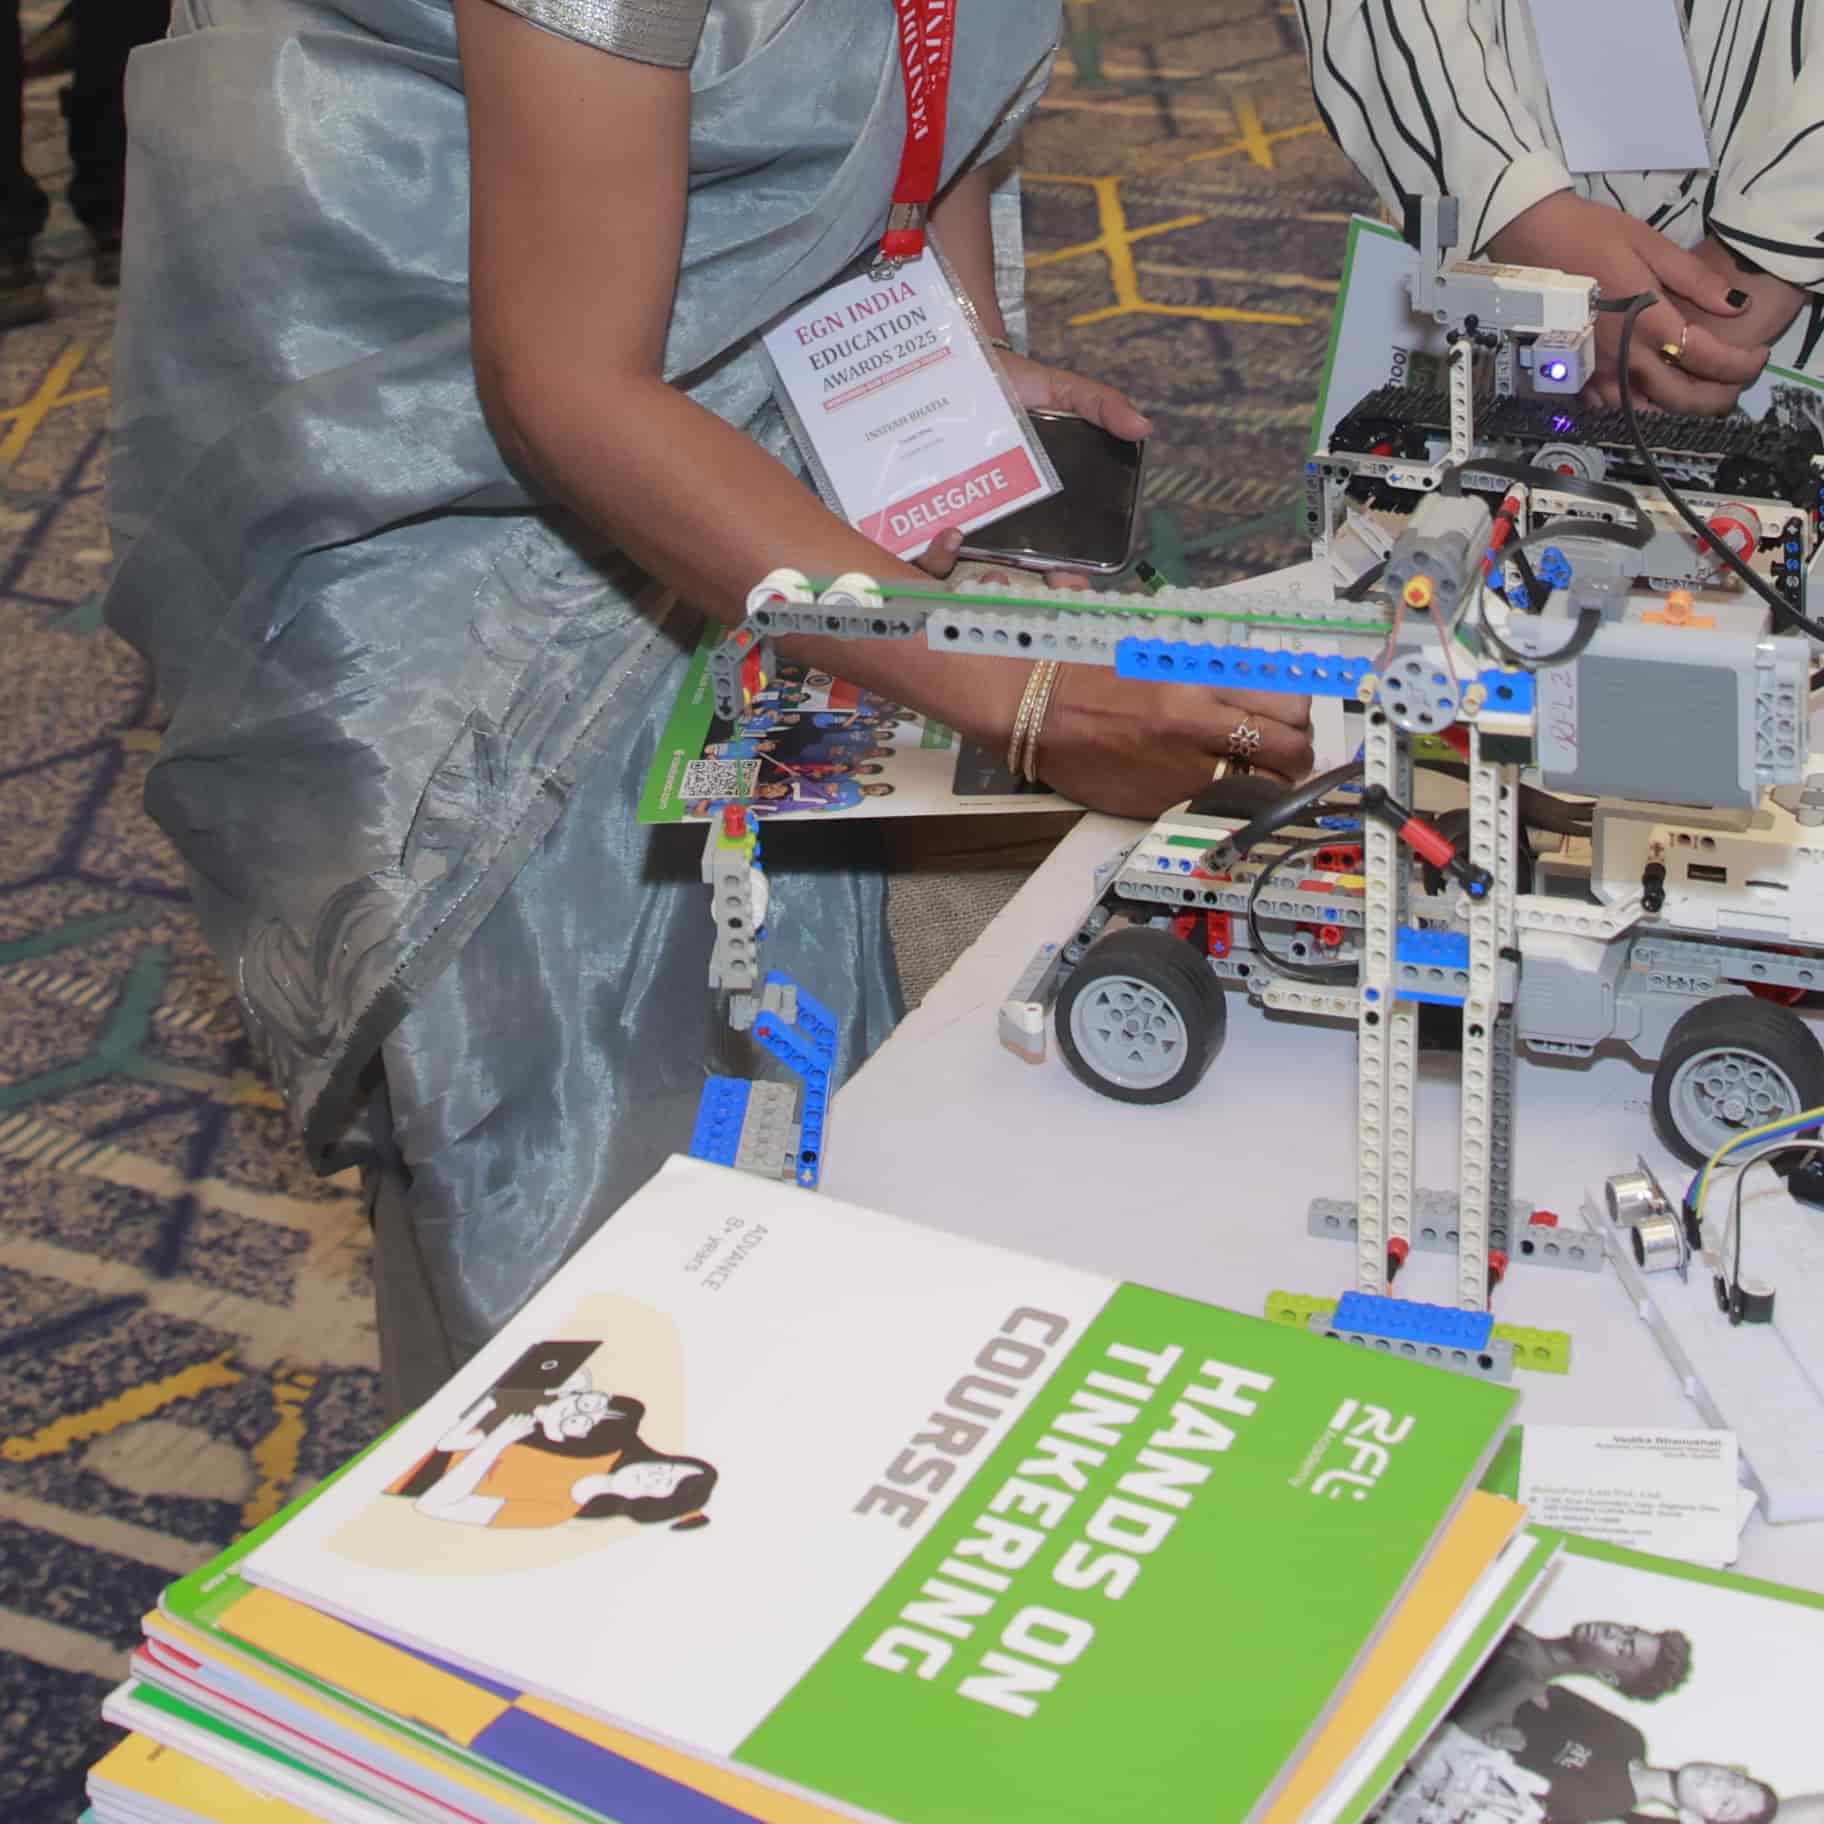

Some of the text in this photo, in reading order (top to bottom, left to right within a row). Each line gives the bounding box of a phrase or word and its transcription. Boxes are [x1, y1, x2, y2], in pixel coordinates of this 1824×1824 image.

[794, 279, 918, 348] EGN INDIA
[807, 305, 929, 374] EDUCATION
[820, 348, 894, 394] AWARDS
[895, 329, 939, 361] 2025
[888, 466, 1010, 538] DELEGATE
[701, 1223, 769, 1293] ADVANCE
[852, 1306, 1071, 1530] COURSE
[862, 1341, 1186, 1682] TINKERING
[955, 1358, 1275, 1719] HANDS ON
